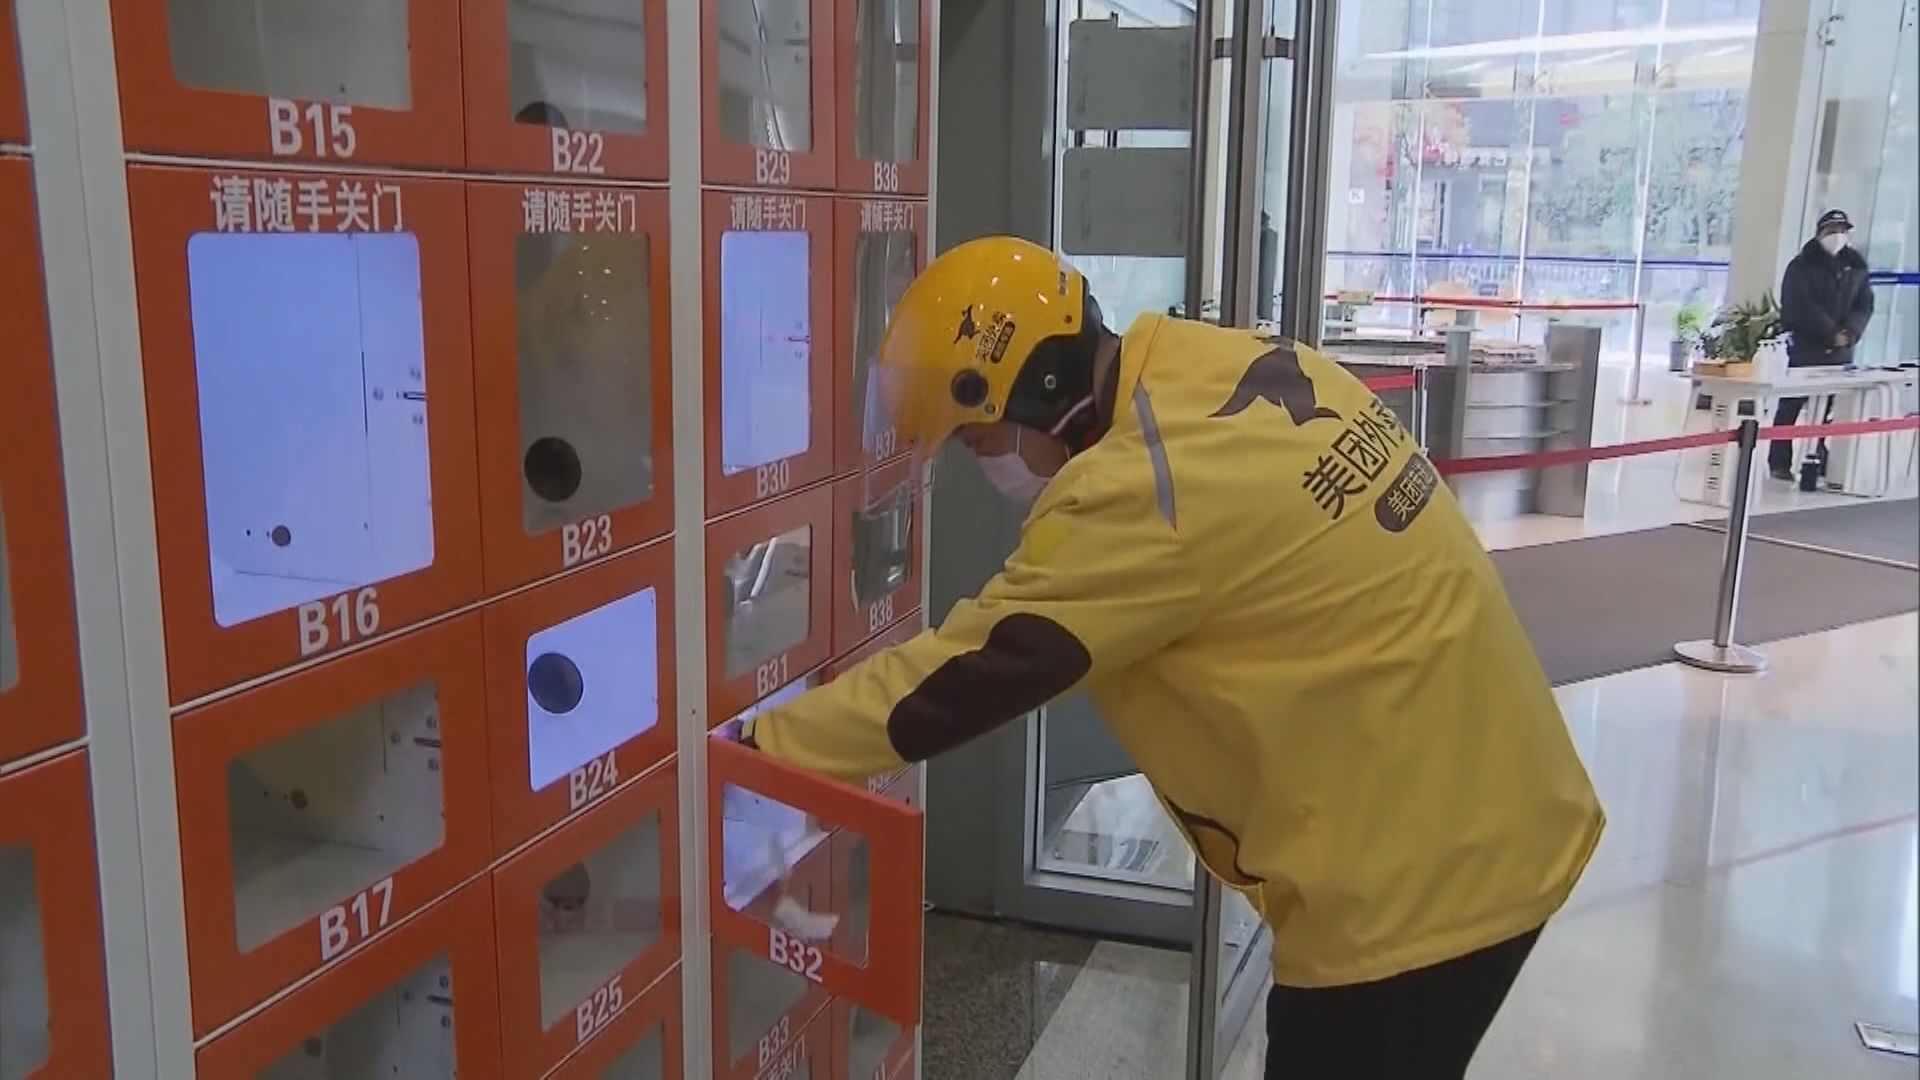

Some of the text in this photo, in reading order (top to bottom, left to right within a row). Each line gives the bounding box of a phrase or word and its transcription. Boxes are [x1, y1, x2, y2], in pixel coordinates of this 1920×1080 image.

[268, 97, 356, 158] B15
[551, 126, 604, 174] B22
[756, 151, 790, 184] B29
[873, 161, 898, 192] B36
[210, 174, 403, 233] 请随手关门
[522, 187, 637, 233] 请随手关门
[730, 196, 807, 231] 请随手关门
[861, 201, 914, 232] 请随手关门
[875, 427, 897, 461] B37
[756, 460, 790, 497] B30
[561, 515, 612, 567] B23
[299, 587, 380, 656] B16
[869, 595, 894, 632] B38
[757, 653, 789, 699] B31
[569, 751, 618, 811] B24
[319, 876, 394, 961] B17
[769, 927, 824, 984] B32
[576, 975, 624, 1043] B25
[758, 1014, 790, 1069] B33
